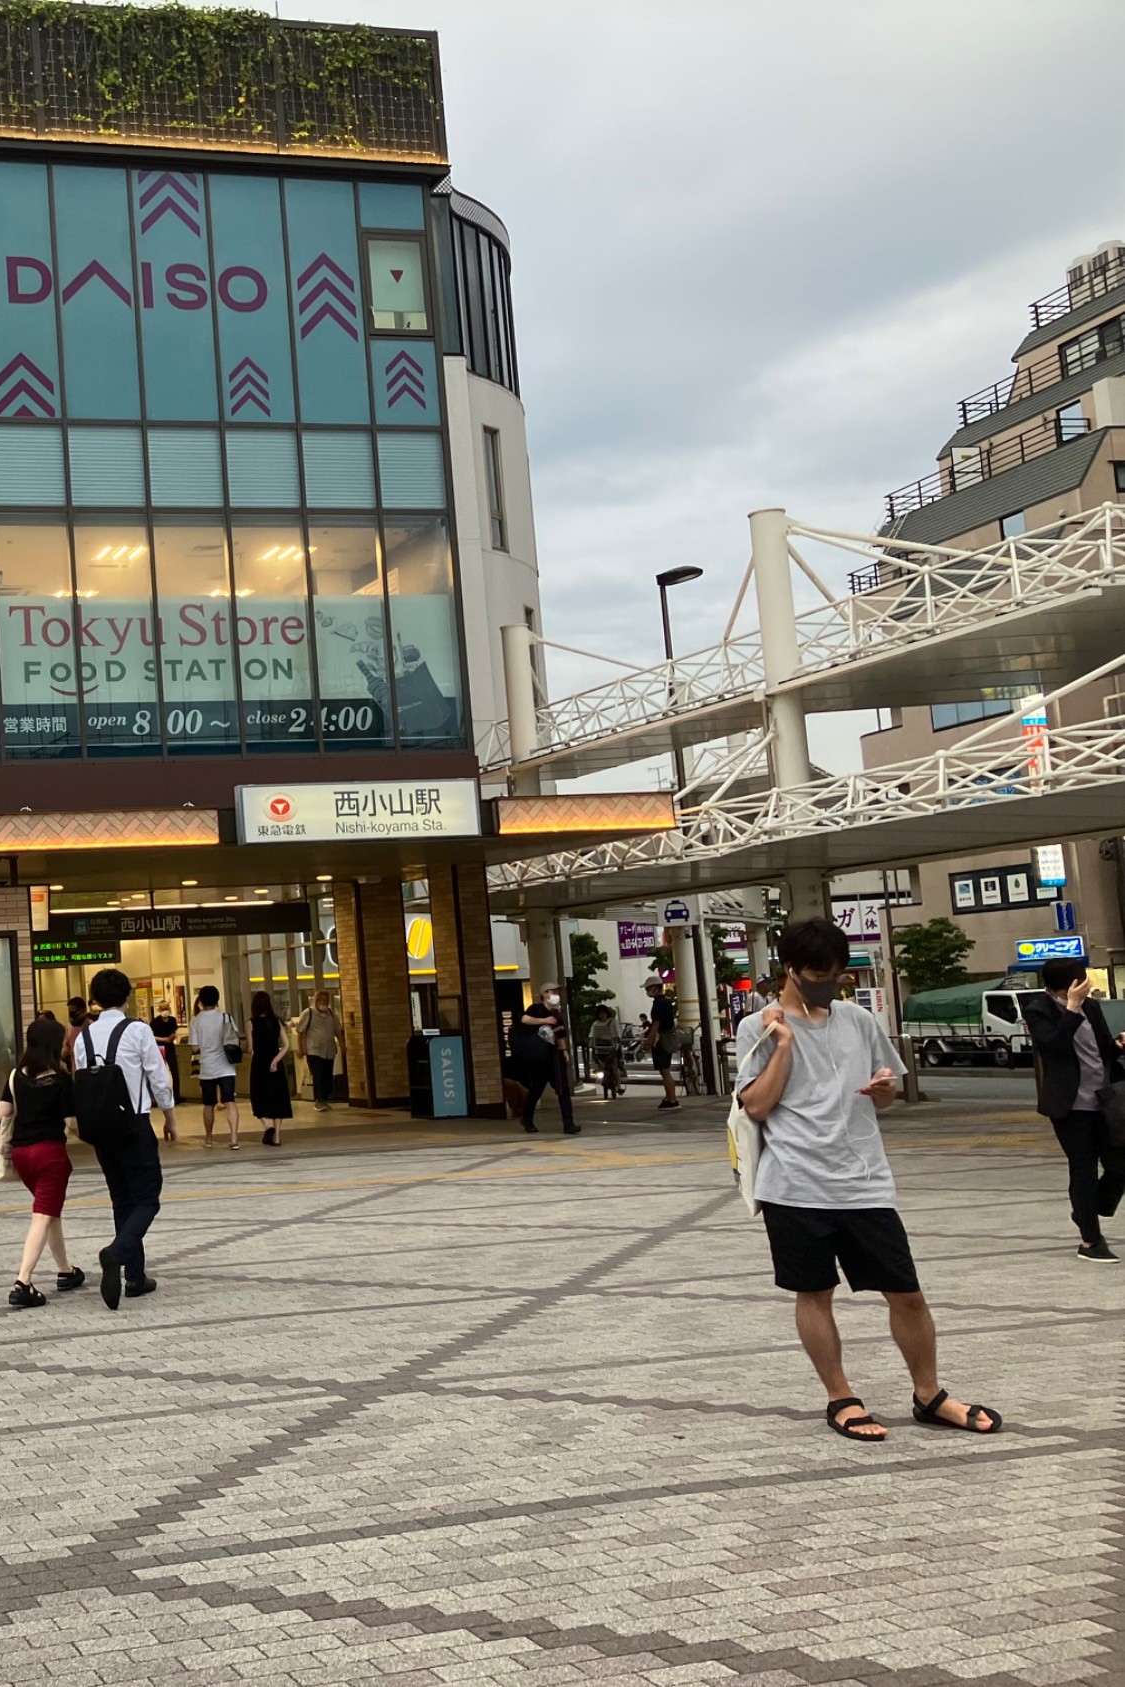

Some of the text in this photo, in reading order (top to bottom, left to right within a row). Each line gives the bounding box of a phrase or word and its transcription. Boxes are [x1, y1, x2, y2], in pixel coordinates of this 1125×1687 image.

[5, 255, 268, 312] DAISO
[8, 603, 306, 656] Tokyu Store
[24, 657, 294, 684] FOOD STATON
[3, 716, 67, 734] 営業時間
[87, 714, 128, 729] open
[132, 708, 204, 736] 800
[246, 710, 287, 725] close
[333, 788, 442, 818] 西小山駅
[257, 824, 307, 836] 東急電鉄
[335, 819, 447, 835] Nishi-koyama Sta.
[120, 915, 182, 933] 西小山駅
[1035, 939, 1079, 953] クリーニング
